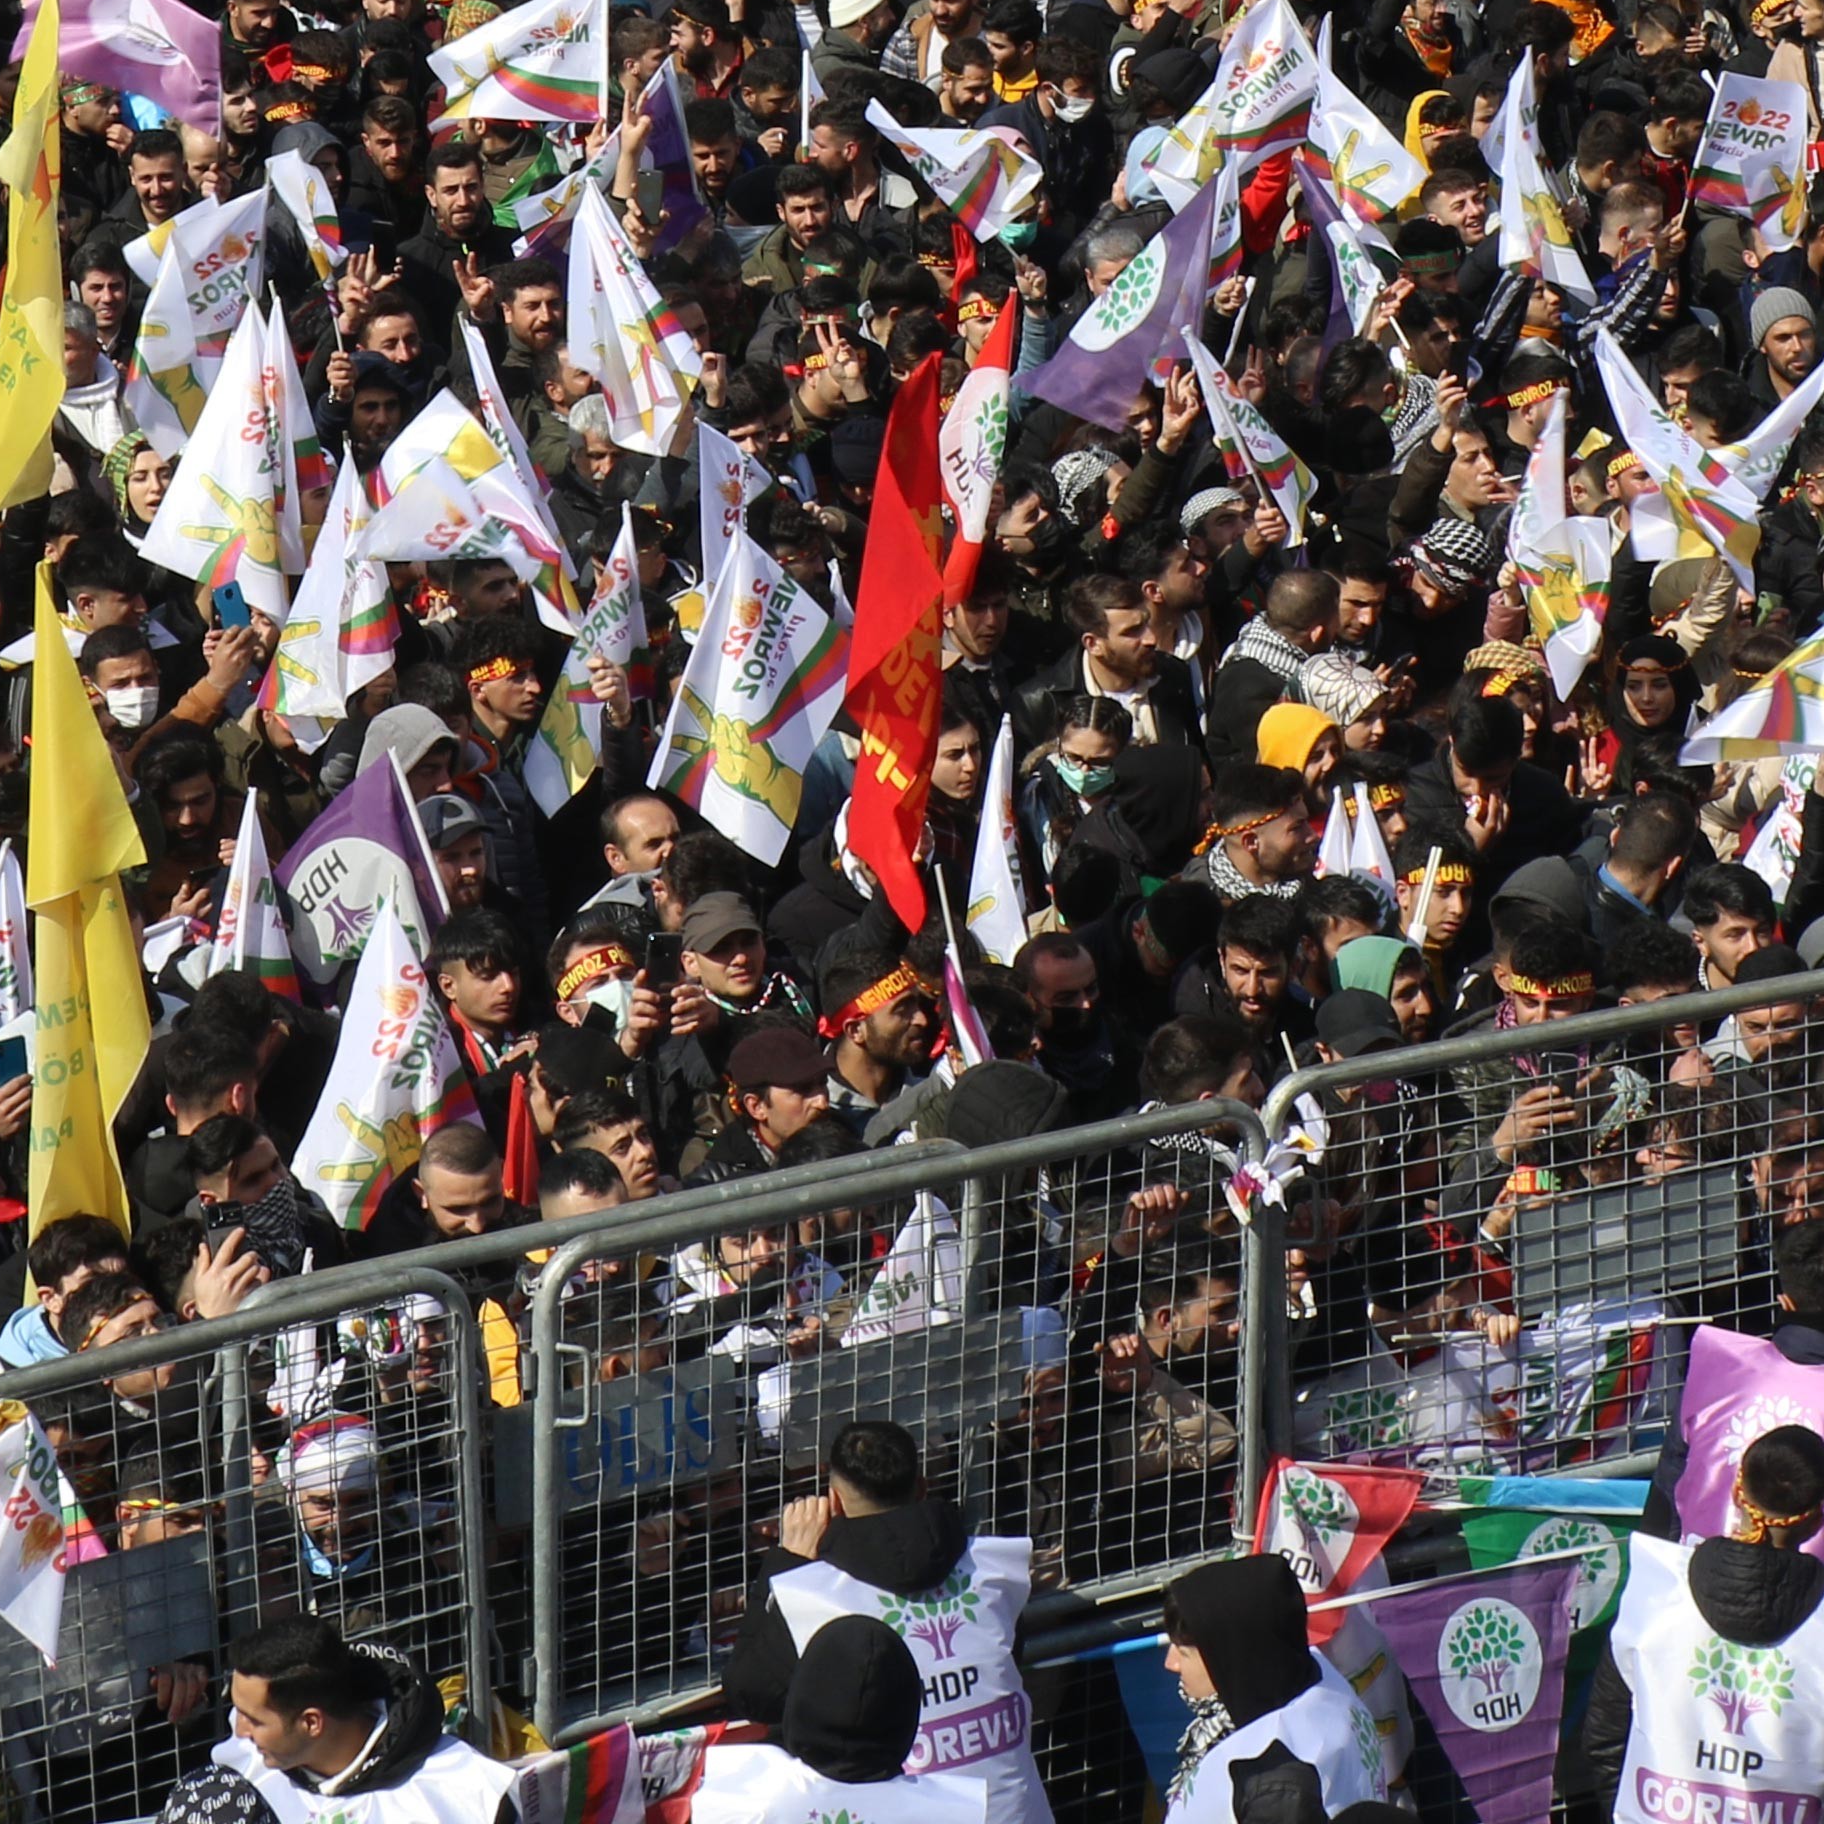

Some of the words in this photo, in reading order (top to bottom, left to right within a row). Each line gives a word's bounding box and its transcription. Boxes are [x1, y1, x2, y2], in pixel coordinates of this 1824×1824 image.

[1722, 99, 1779, 131] 2022
[1507, 381, 1555, 407] NEWROZ
[294, 850, 347, 910] HDP
[559, 956, 604, 998] NEWROZ
[854, 967, 913, 1014] NEWROZ
[1696, 1741, 1762, 1774] HDP
[1640, 1772, 1821, 1823] GÖREVLİ
